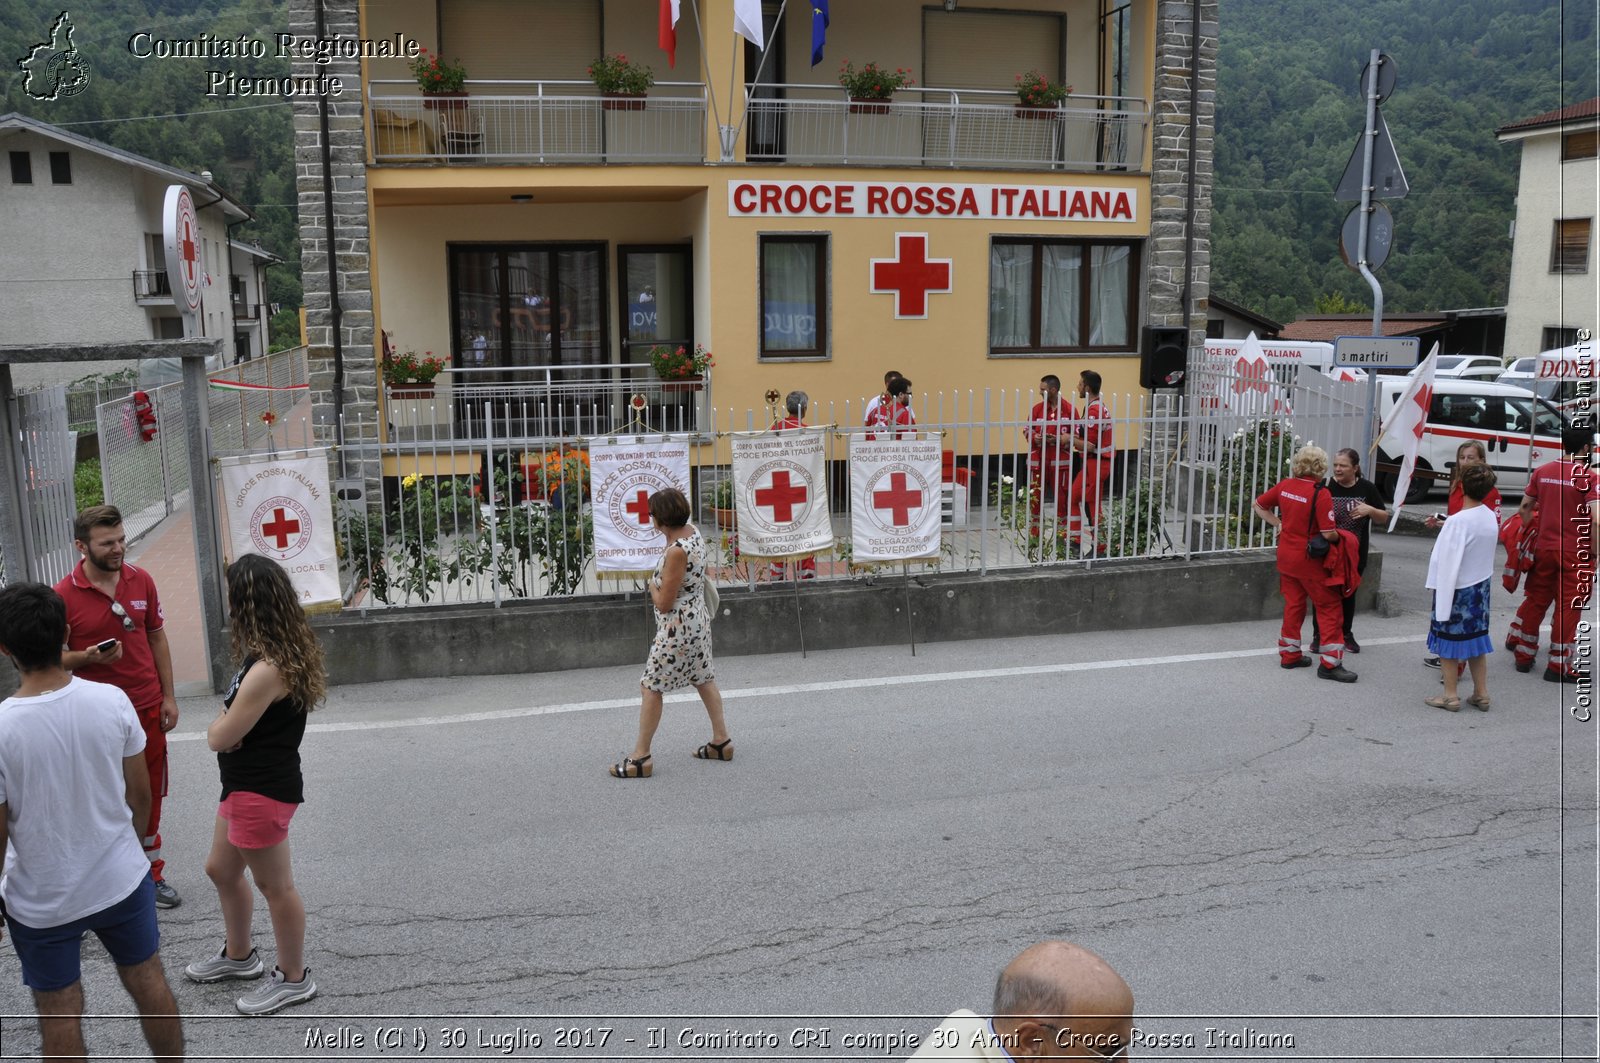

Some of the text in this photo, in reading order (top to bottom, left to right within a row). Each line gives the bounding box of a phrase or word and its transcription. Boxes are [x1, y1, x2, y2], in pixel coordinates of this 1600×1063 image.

[733, 184, 1133, 219] CROCE ROSSA ITALIANA
[1263, 350, 1302, 358] TALIANA
[1341, 351, 1389, 362] 3 martiri
[736, 437, 820, 450] CORPO VOLONTARI DEL SOCCORSO
[616, 452, 644, 460] VOLONTARI
[646, 451, 657, 459] DEL
[659, 450, 684, 458] SOCCORSO
[733, 445, 824, 459] CROCE ROSSA ITALIANA
[874, 446, 900, 454] VOLONTARI
[851, 453, 940, 463] CROCE ROSSA ITALIANA
[235, 467, 320, 508] CROCE ROSSA ITALIANA
[596, 461, 687, 503] CROCE ROSSA ITALIAN
[746, 529, 822, 543] COMITATO LOCALE DI
[868, 535, 931, 546] DELEGAZIONE DI
[597, 546, 666, 557] GRUPPO DI PONTEC
[758, 542, 814, 554] RACCONIGI
[872, 544, 928, 555] PEVERAGNO
[291, 563, 326, 574] LOCALE
